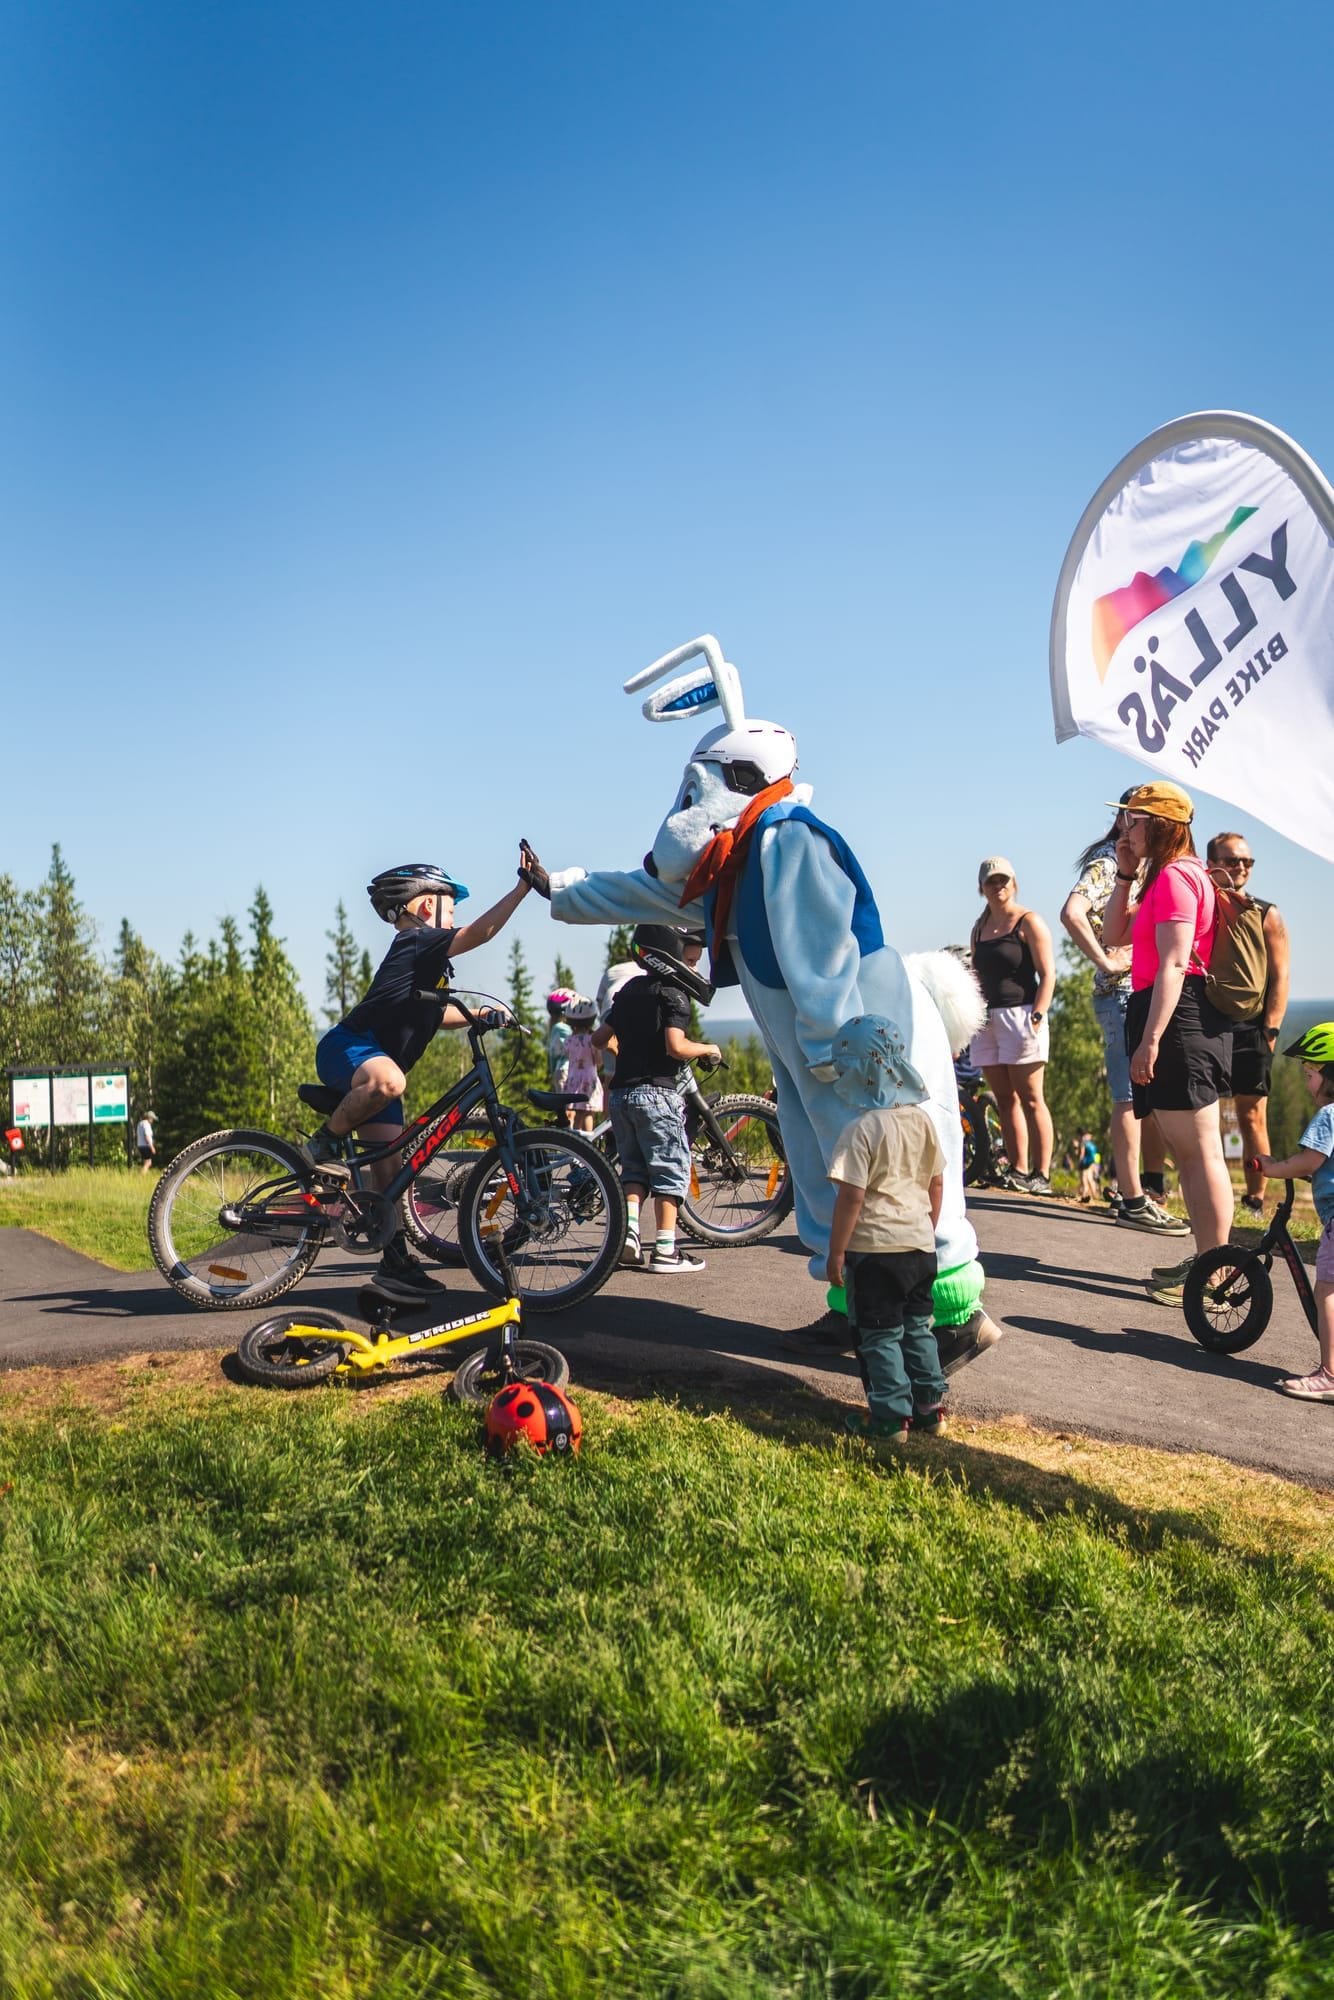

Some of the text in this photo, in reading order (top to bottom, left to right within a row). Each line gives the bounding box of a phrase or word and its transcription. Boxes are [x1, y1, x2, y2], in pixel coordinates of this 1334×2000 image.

[643, 953, 677, 976] LEATT
[410, 1104, 462, 1173] RAGE
[408, 1310, 491, 1344] STRIDER
